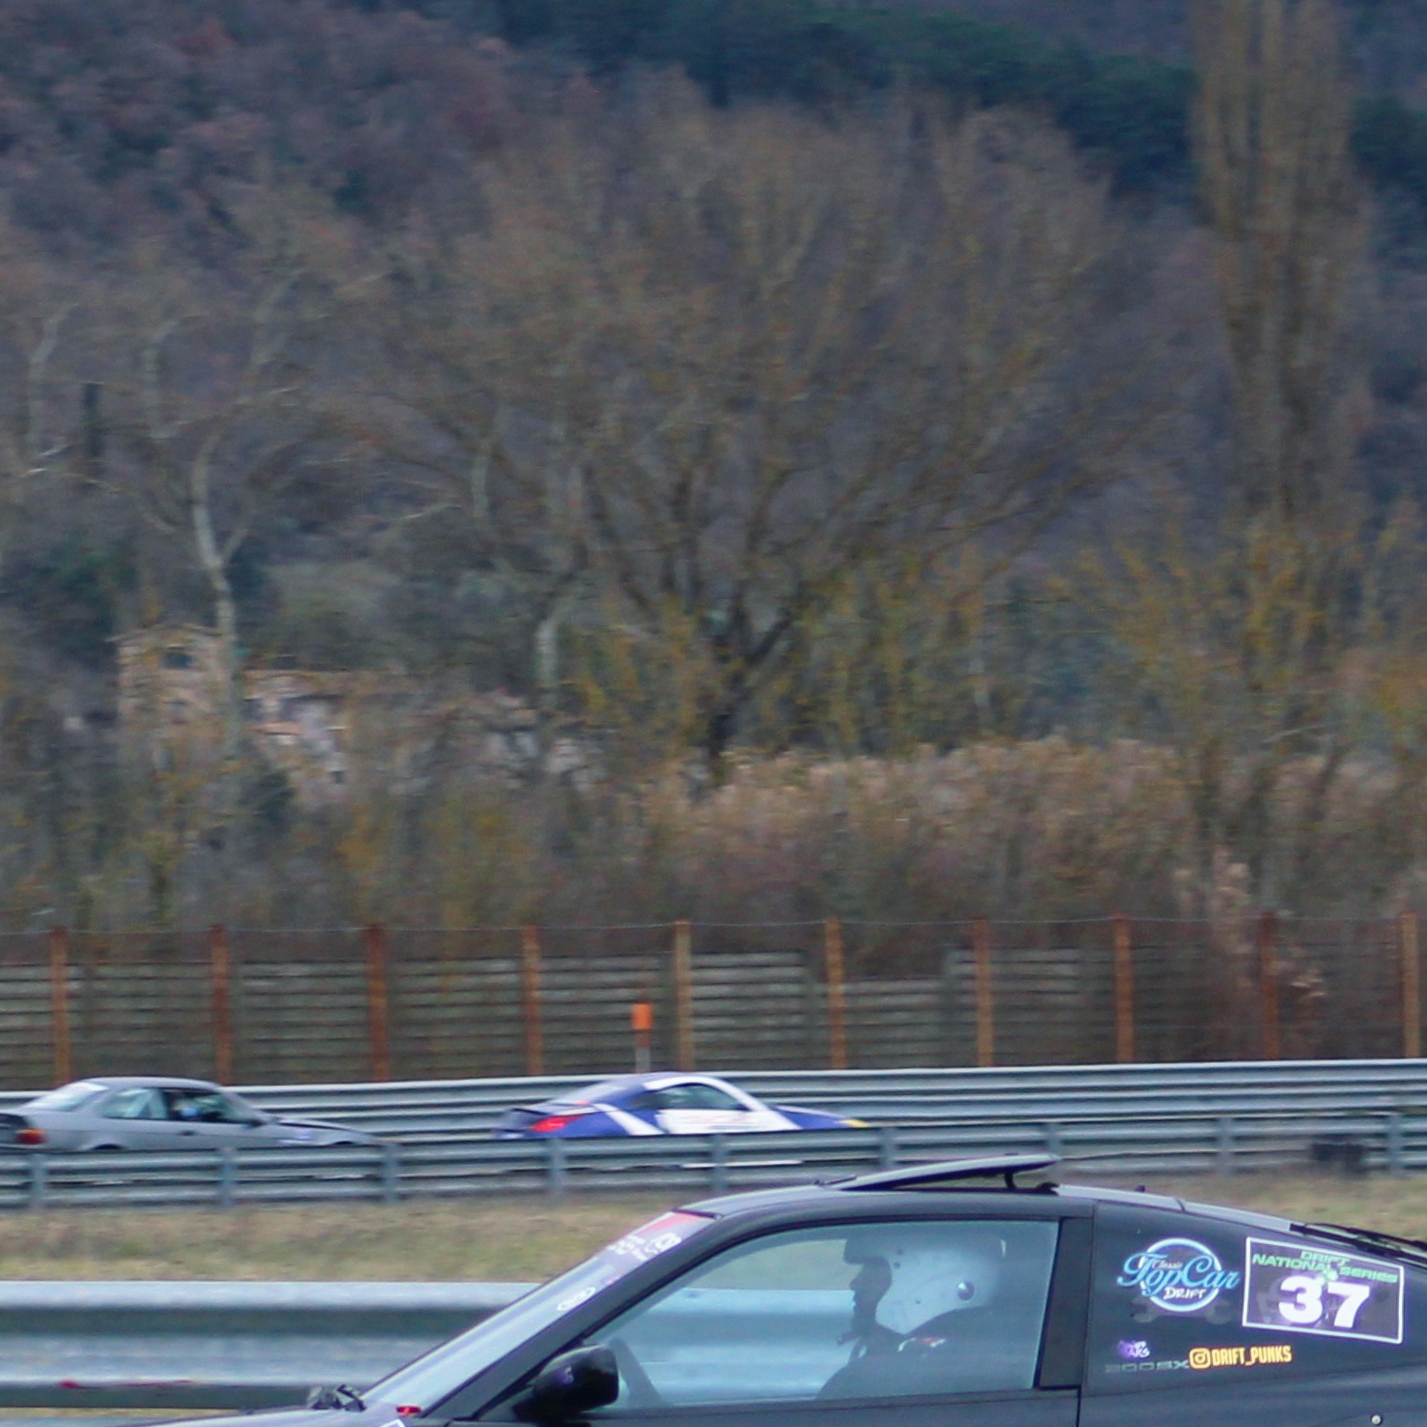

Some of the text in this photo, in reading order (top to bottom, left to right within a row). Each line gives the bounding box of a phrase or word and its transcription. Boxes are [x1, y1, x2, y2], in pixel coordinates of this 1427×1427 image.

[1252, 1254, 1398, 1283] NATIONAL SERIES
[1301, 1251, 1350, 1266] DRIFT
[1163, 1286, 1207, 1299] DRIFT
[1278, 1275, 1370, 1328] 37
[1212, 1345, 1292, 1366] DRIFT_PUNKS
